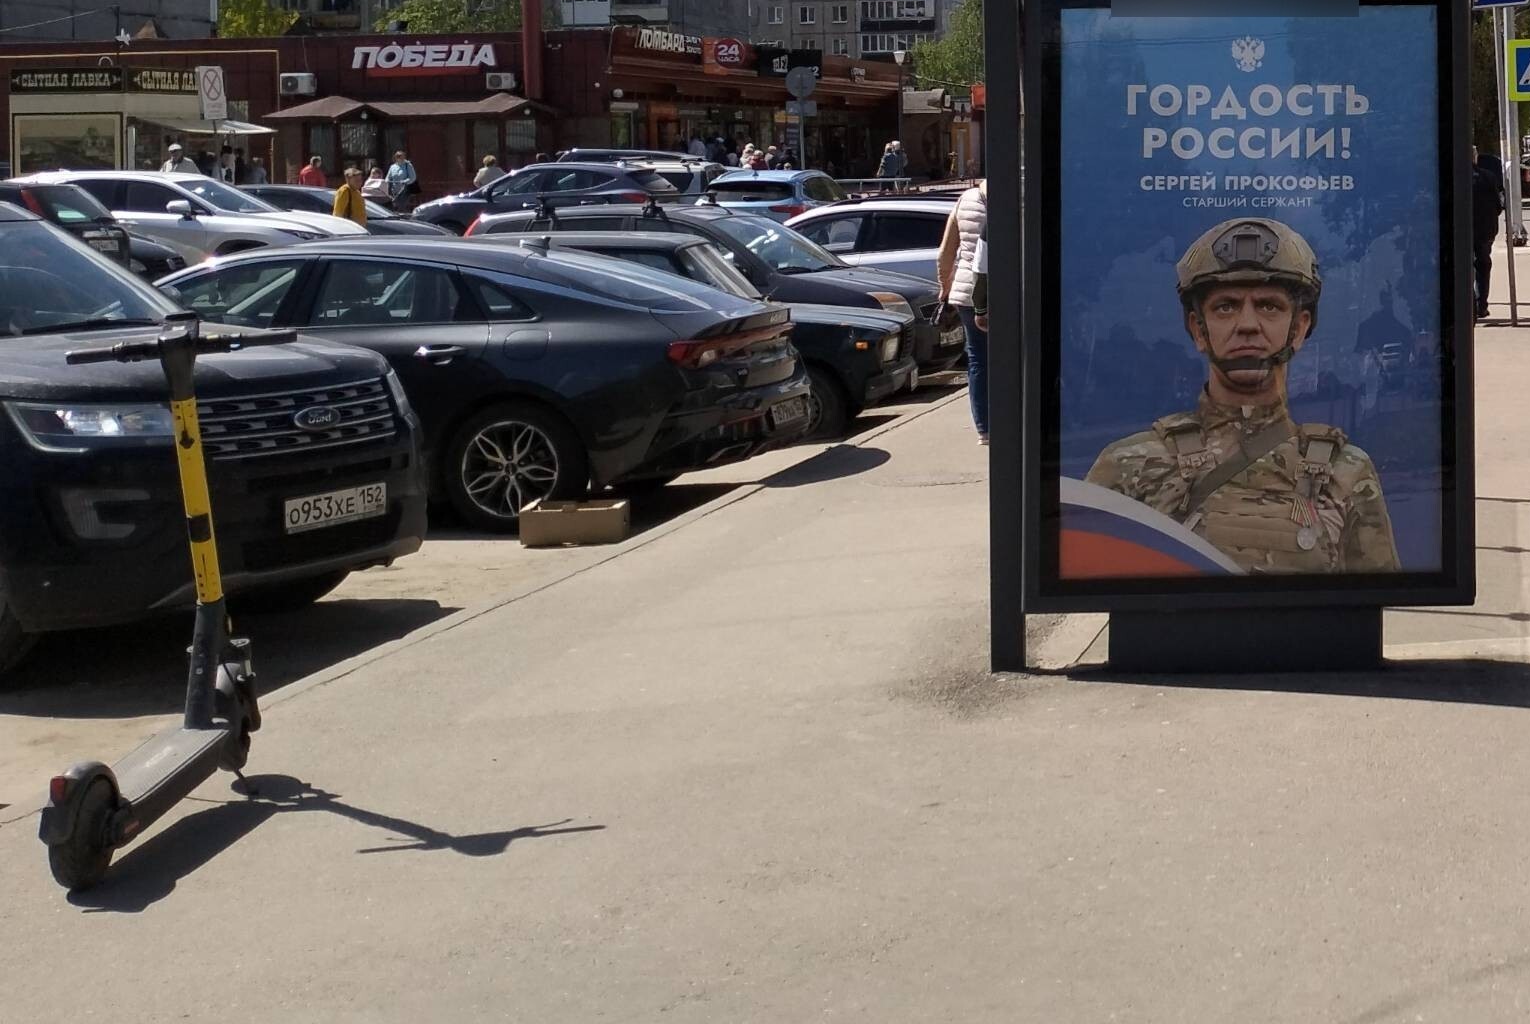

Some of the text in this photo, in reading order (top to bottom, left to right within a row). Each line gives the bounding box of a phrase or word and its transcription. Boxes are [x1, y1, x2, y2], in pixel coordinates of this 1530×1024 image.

[639, 28, 686, 52] ЛОМБАРД
[717, 44, 740, 56] 24
[352, 43, 496, 70] ПОБЕДА
[21, 72, 111, 88] СЫТНАЯ ЛАВКА
[141, 70, 179, 90] СЫТНАЯ
[1126, 83, 1370, 121] ГОРДОСТЬ
[1143, 126, 1352, 160] РОССИИ!
[1140, 171, 1355, 191] СЕРГЕЙ ПРОКОФЬЕВ
[1182, 194, 1313, 208] СТАРШИЙ СЕРЖАНТ
[289, 486, 383, 525] О953ХЕ 152
